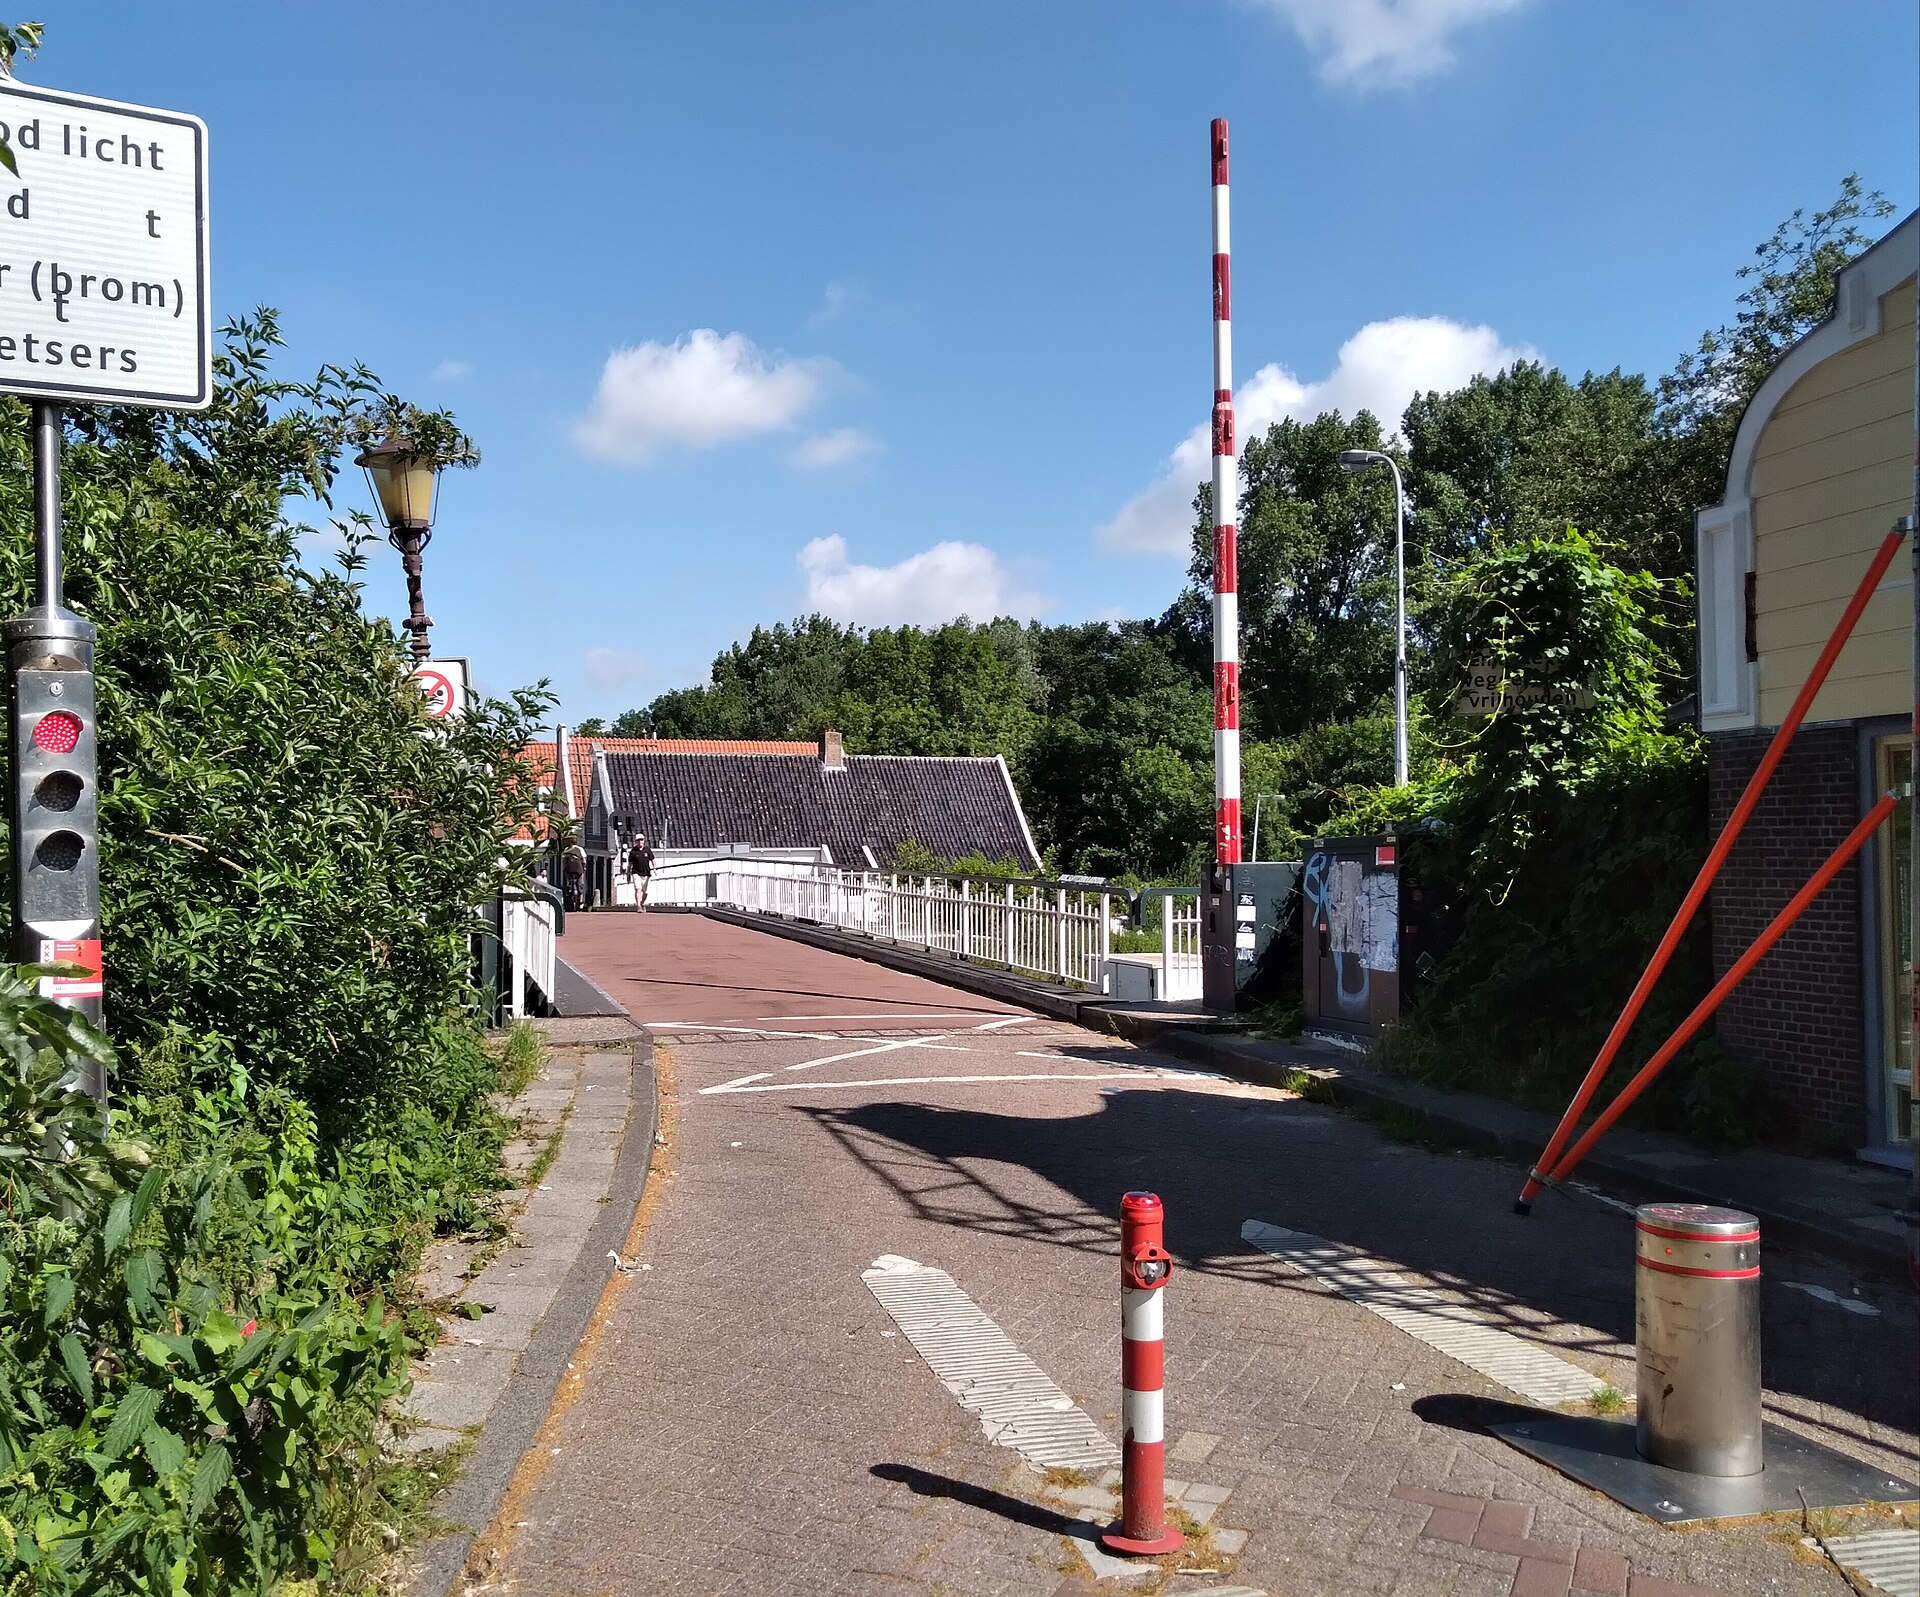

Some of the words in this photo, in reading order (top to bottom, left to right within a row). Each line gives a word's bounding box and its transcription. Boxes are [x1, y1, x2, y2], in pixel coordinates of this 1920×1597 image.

[63, 124, 164, 170] licht
[145, 209, 161, 238] t
[31, 261, 184, 318] (brom)
[0, 333, 137, 373] etsers
